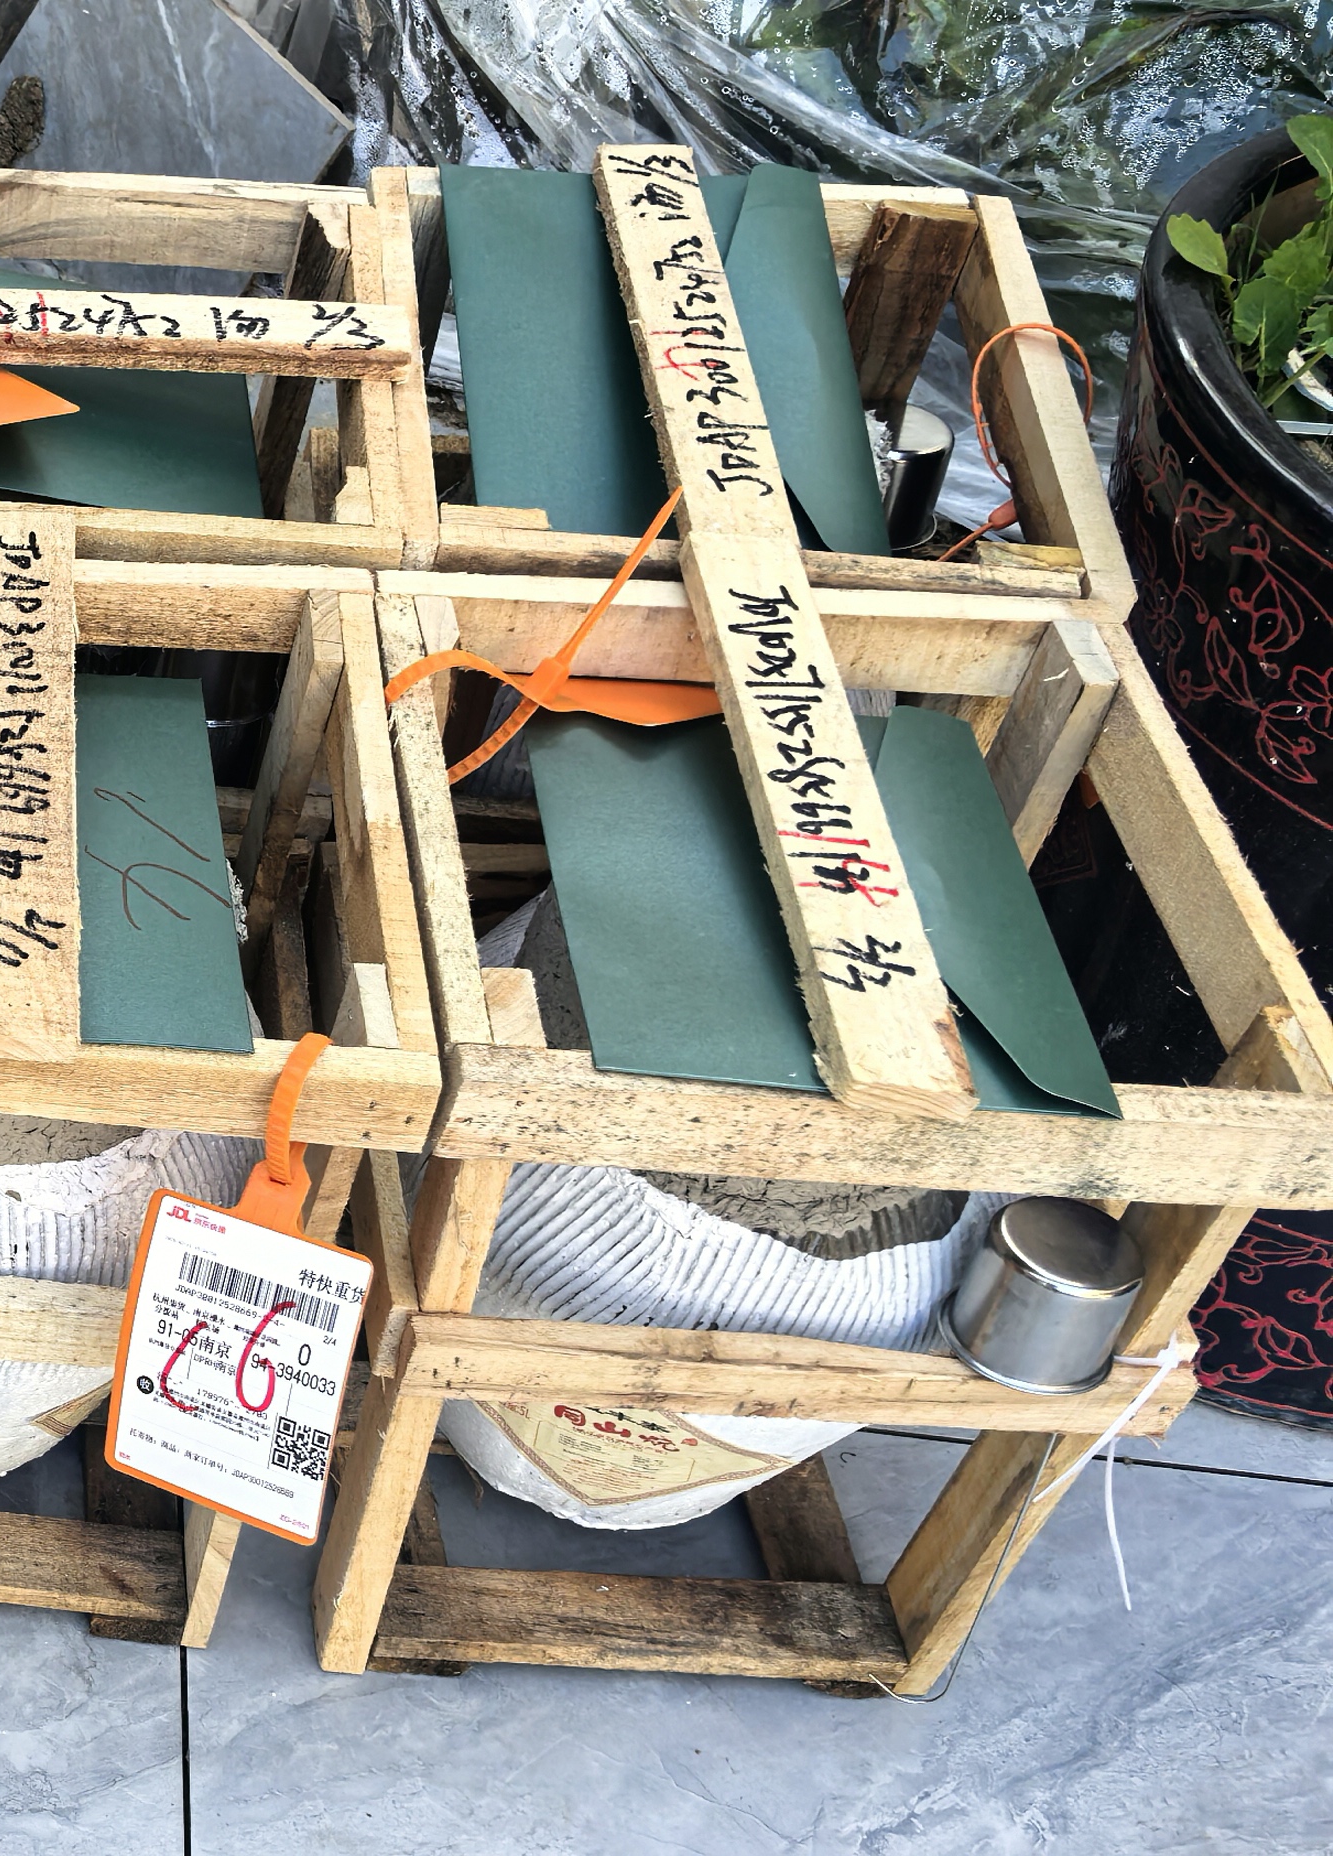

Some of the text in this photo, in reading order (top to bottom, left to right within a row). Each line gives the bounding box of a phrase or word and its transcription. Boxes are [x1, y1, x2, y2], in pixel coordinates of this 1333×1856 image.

[306, 304, 385, 350] 2/3
[166, 1205, 192, 1224] JDL
[298, 1268, 367, 1306] 特快重货
[156, 1319, 233, 1360] 91-05南京
[297, 1343, 312, 1367] 0
[322, 1334, 338, 1348] 2/4
